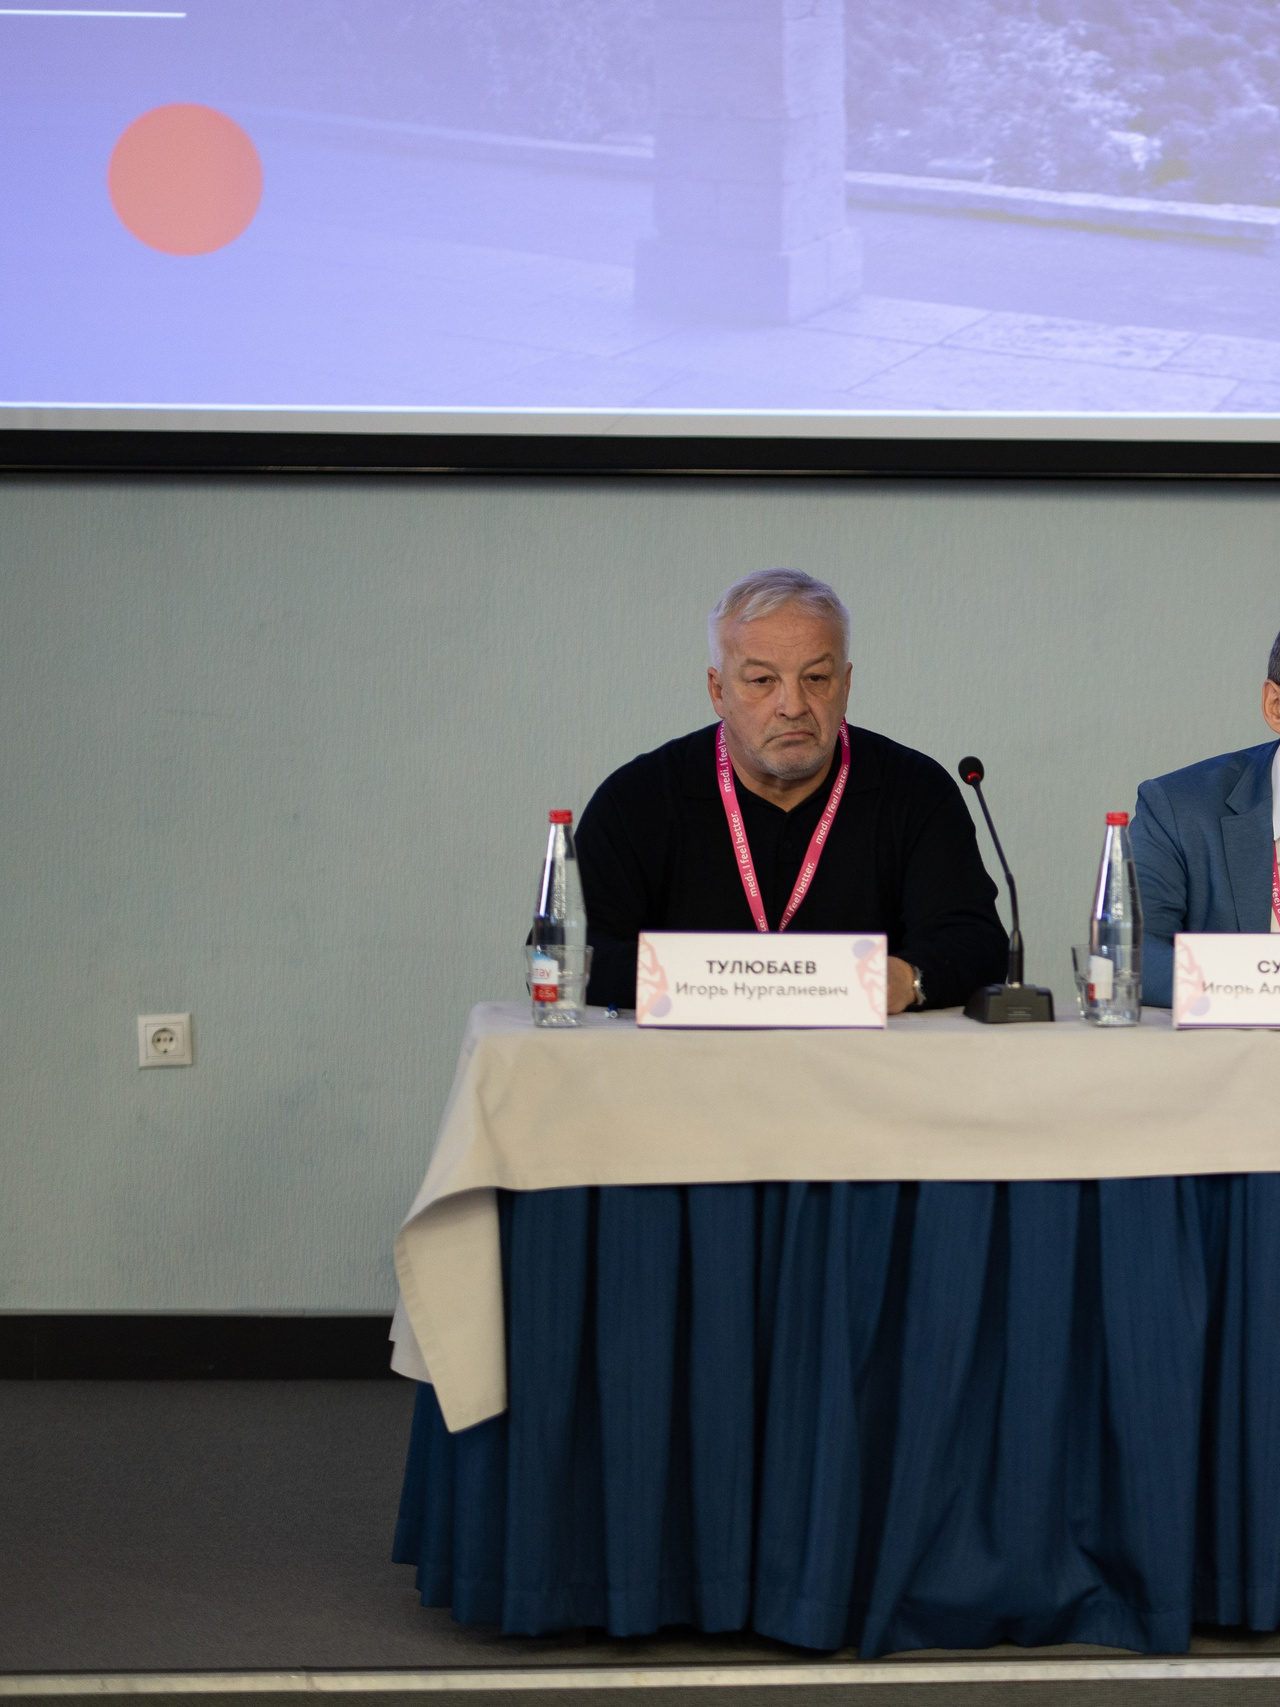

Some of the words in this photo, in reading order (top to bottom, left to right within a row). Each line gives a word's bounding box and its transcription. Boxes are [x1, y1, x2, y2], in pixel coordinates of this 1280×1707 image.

[719, 745, 728, 762] feel
[720, 766, 731, 792] medi.
[816, 819, 830, 844] medi.
[828, 795, 839, 813] feel
[835, 764, 848, 794] better.
[731, 810, 744, 844] better.
[737, 845, 749, 864] feel
[744, 870, 758, 897] medi.
[788, 893, 802, 912] feel
[796, 862, 815, 893] better.
[706, 959, 817, 975] ТУЛЮБАЕВ
[675, 982, 728, 1000] Игорь
[734, 983, 849, 1000] Нургалиевич
[1202, 981, 1254, 998] Игорь
